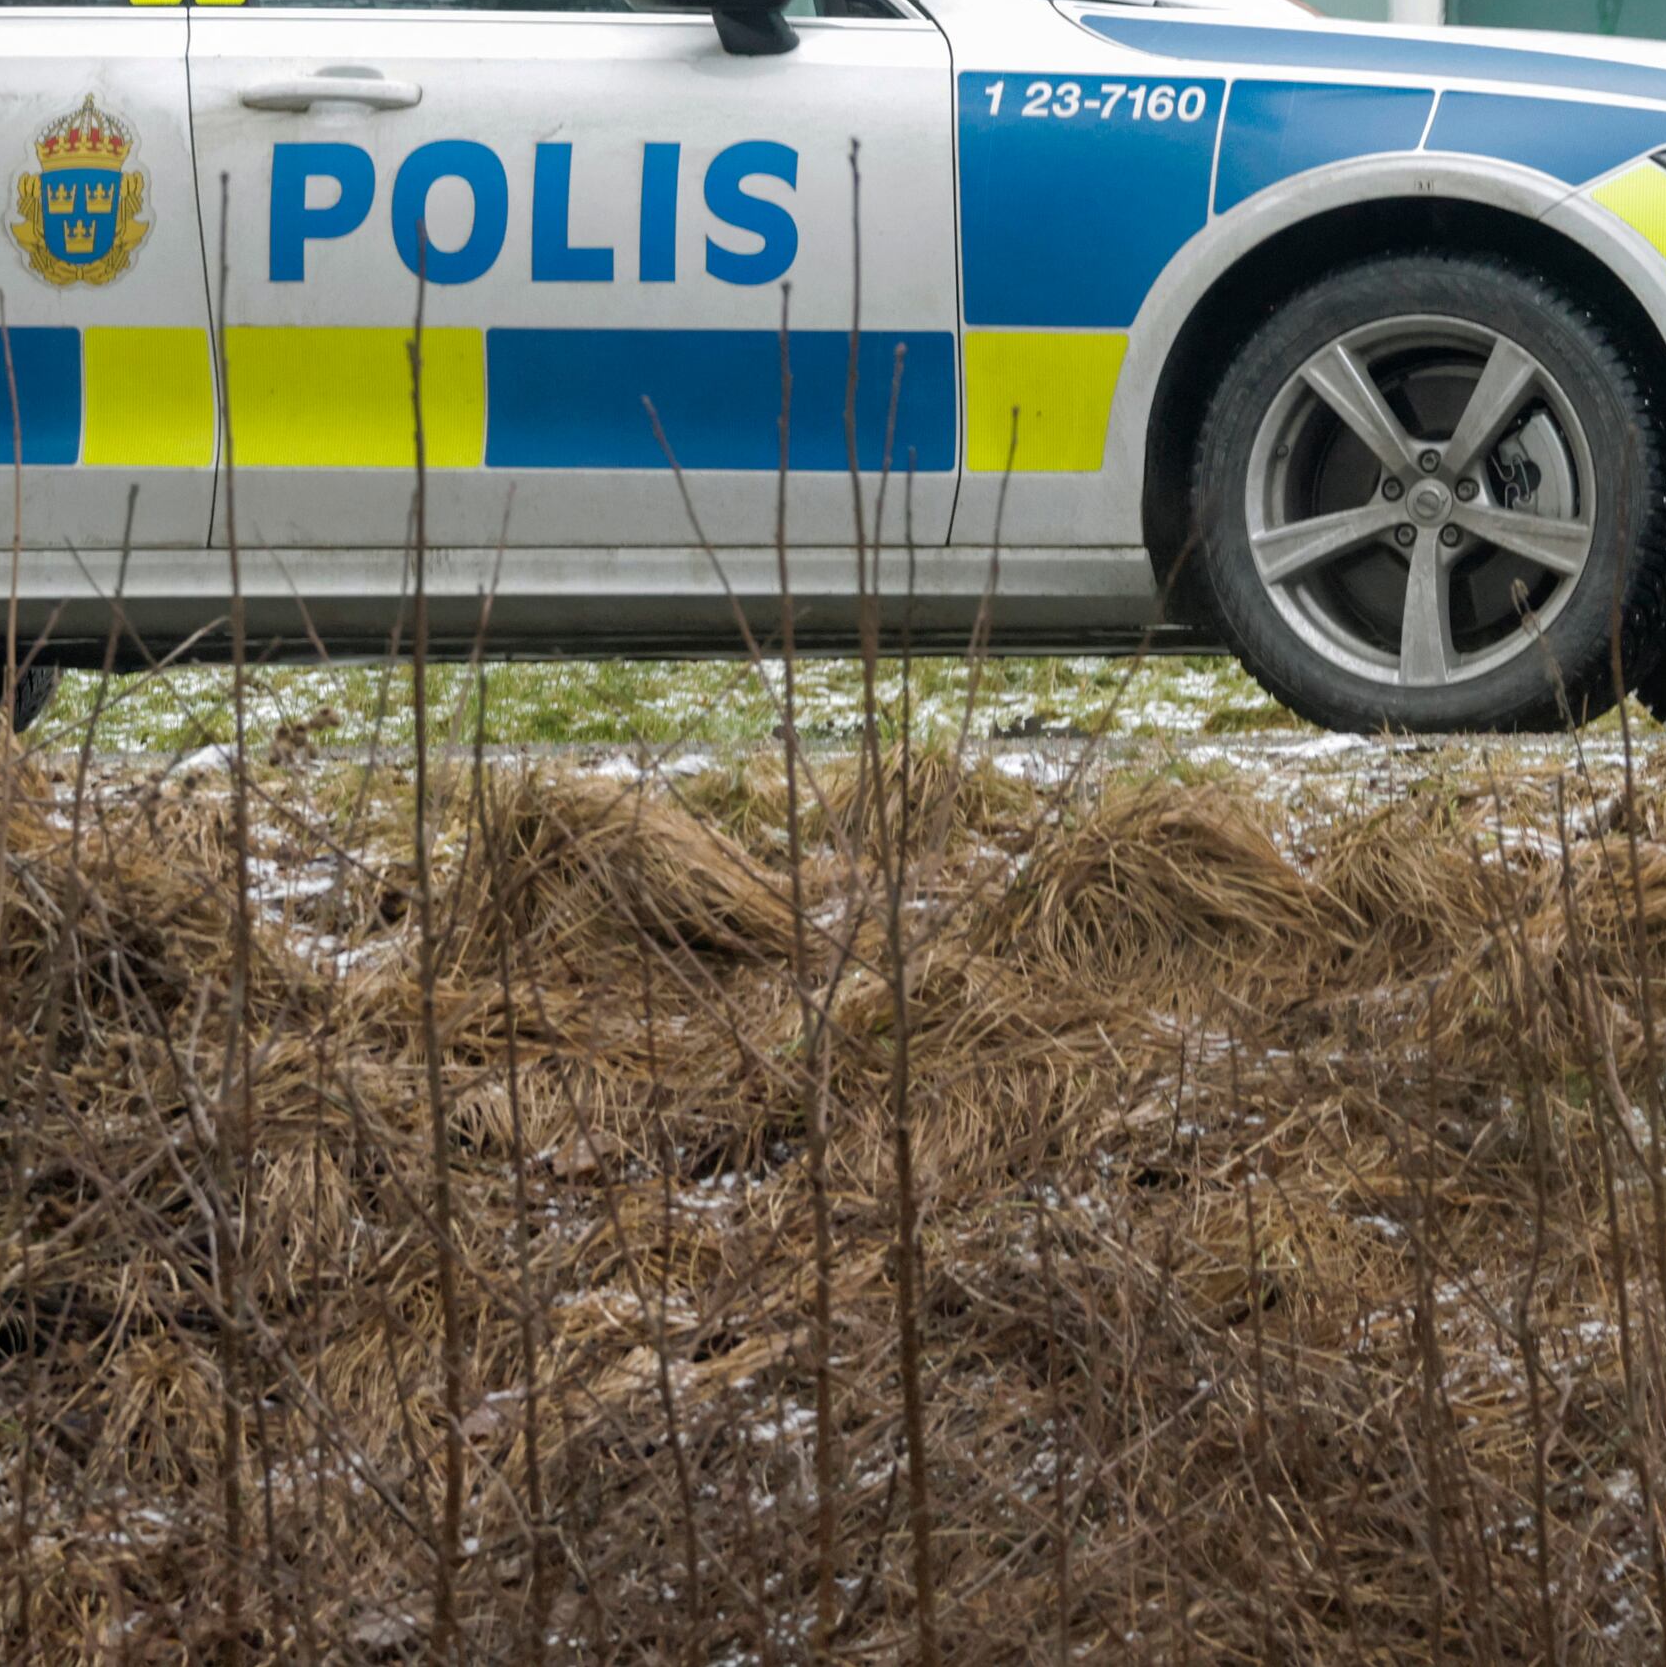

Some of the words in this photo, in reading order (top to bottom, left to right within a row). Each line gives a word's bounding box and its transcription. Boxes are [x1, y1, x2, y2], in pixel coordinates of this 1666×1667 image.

[985, 81, 1005, 116] 1
[1021, 82, 1207, 122] 23-7160
[269, 139, 799, 286] POLIS
